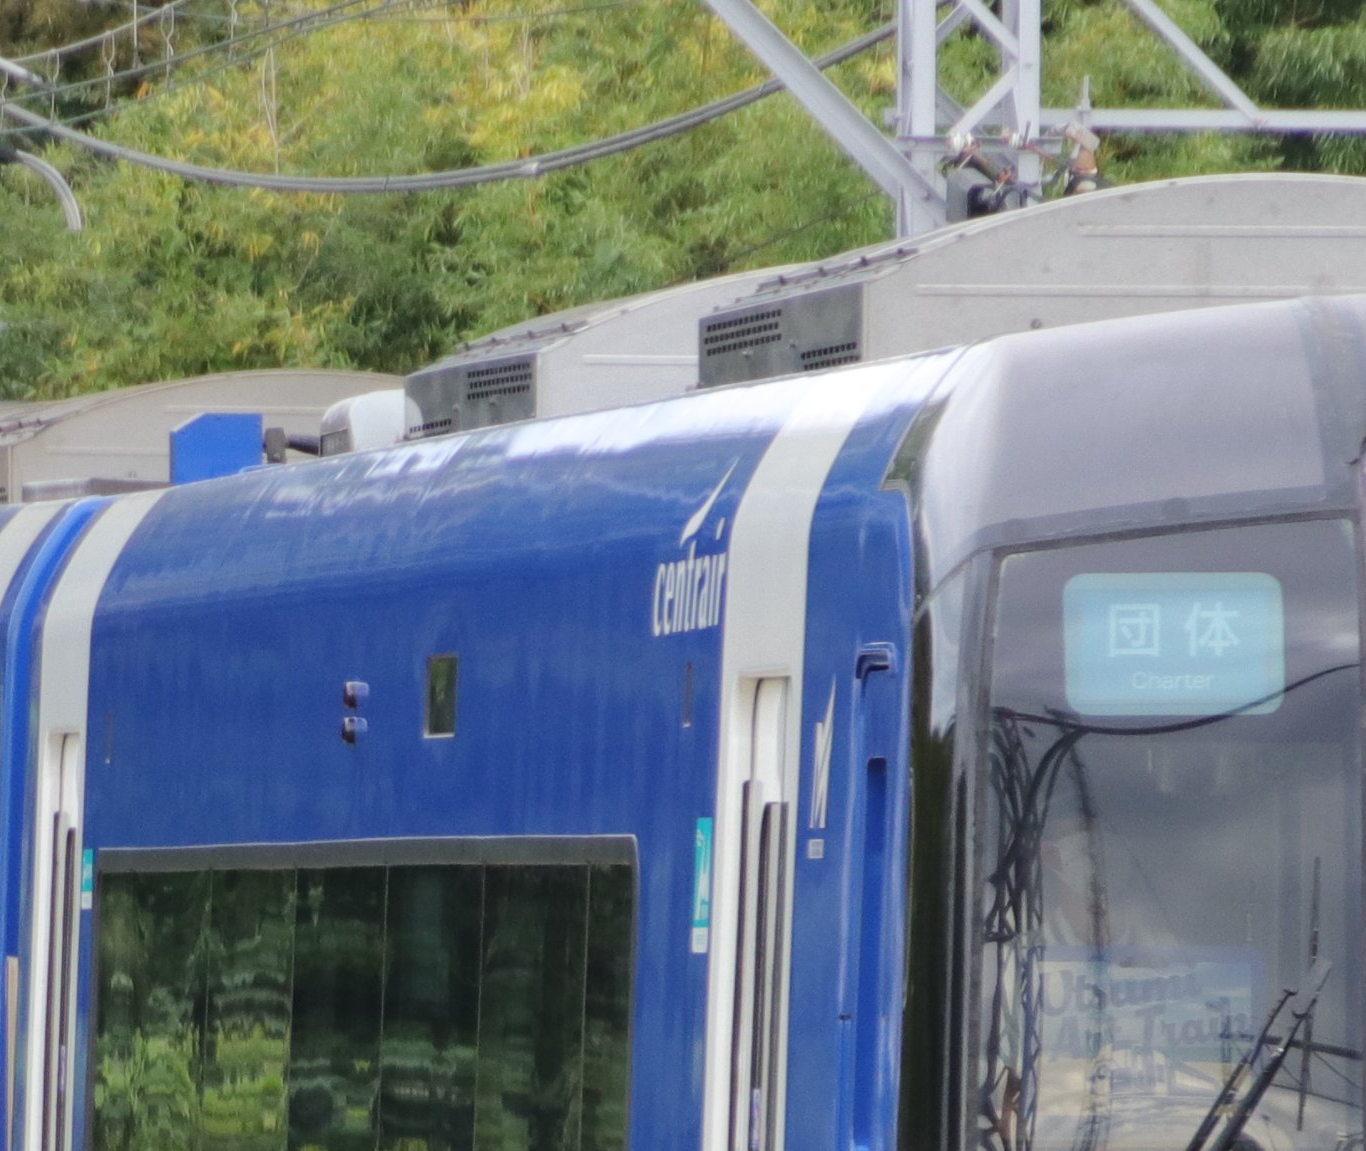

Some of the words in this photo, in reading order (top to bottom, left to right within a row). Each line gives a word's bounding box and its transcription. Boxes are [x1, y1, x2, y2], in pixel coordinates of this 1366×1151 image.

[653, 492, 729, 637] centrair
[1108, 602, 1241, 657] 団体
[1132, 671, 1215, 689] Charter
